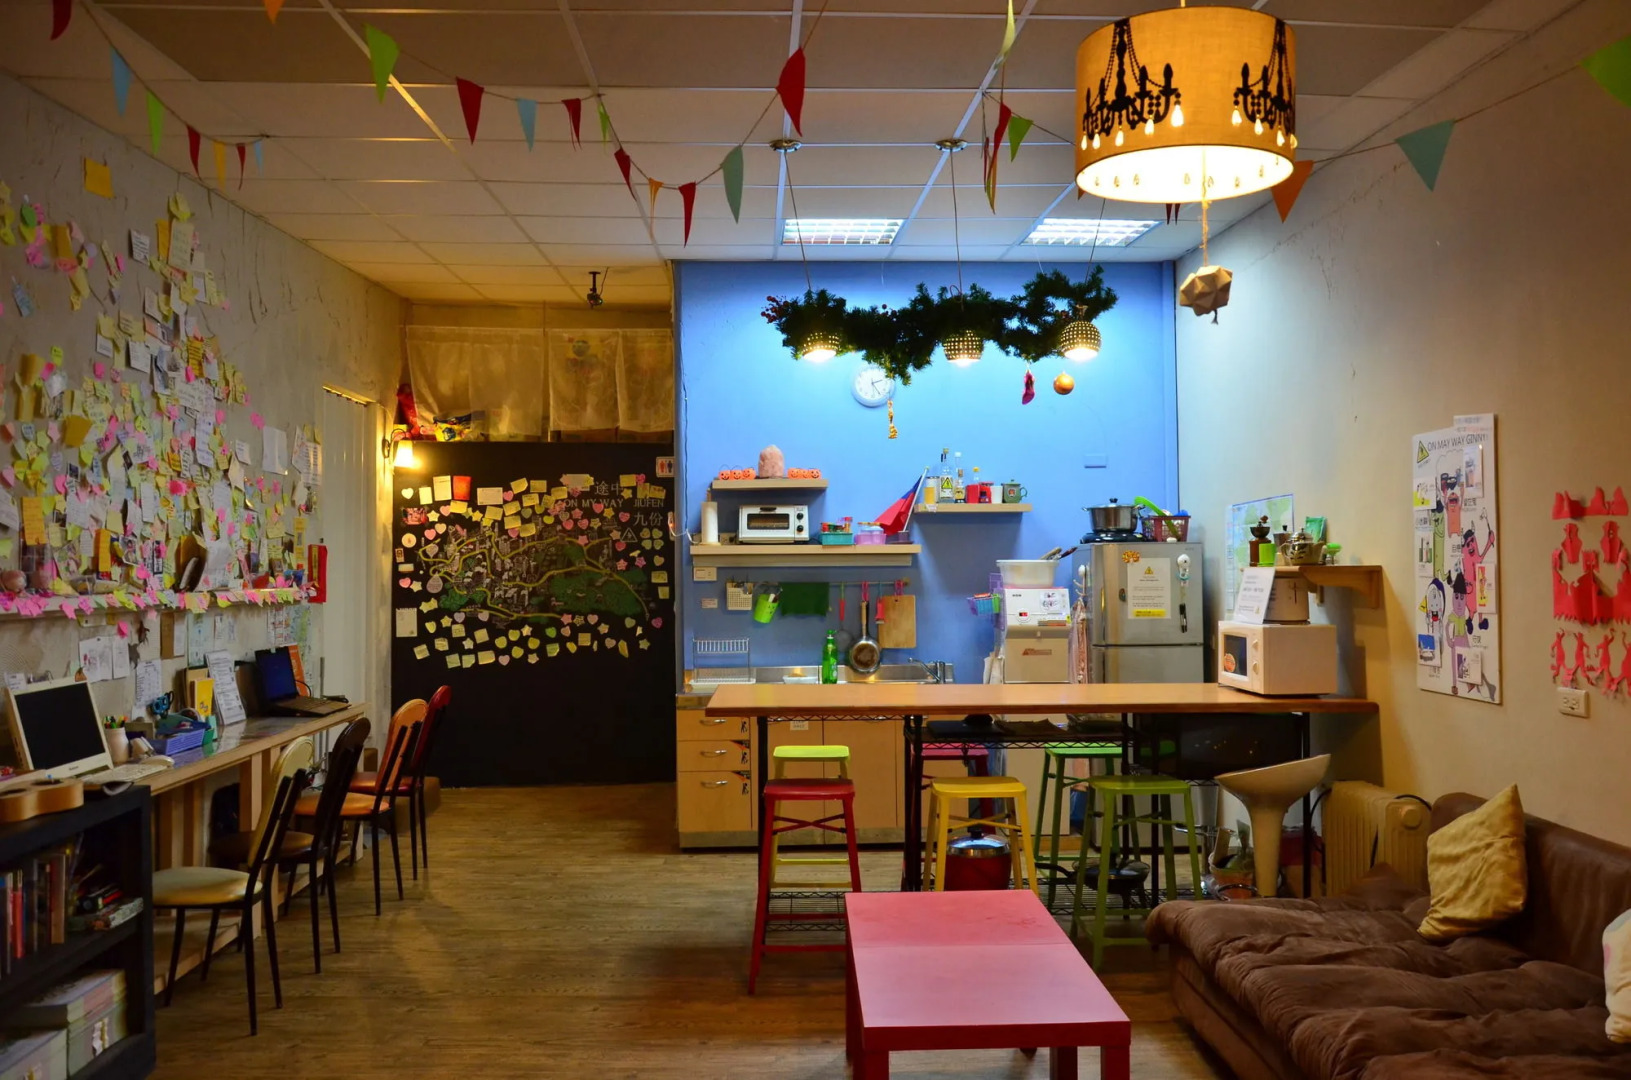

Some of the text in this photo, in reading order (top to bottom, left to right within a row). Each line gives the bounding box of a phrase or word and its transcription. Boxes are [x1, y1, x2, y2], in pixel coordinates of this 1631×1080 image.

[1427, 441, 1437, 452] ON
[1451, 437, 1465, 448] WAY
[565, 499, 624, 507] ON MY WAY
[634, 499, 664, 507] JIUFEN
[633, 512, 663, 526] 九份
